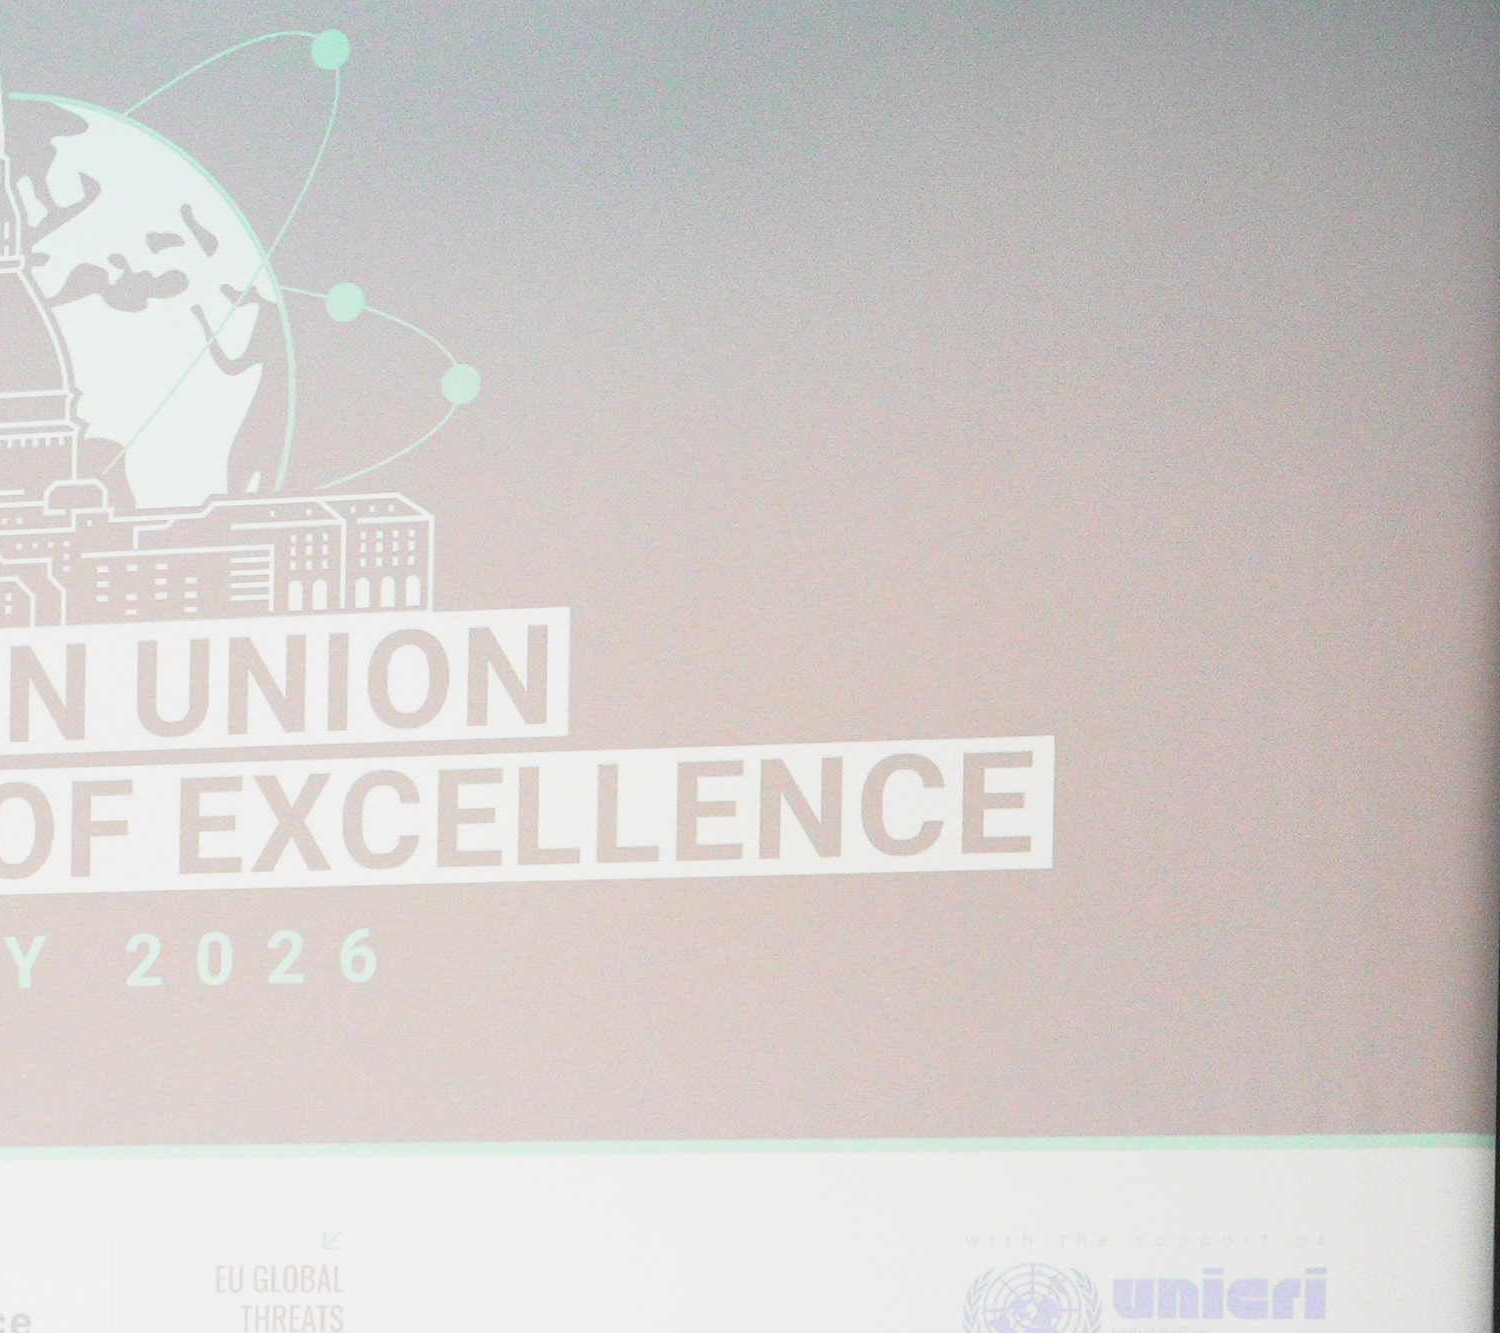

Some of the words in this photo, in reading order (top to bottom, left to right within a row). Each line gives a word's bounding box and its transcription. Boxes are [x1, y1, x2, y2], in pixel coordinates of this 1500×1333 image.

[134, 624, 551, 737] UNION
[177, 749, 1035, 876] EXCELLENCE
[125, 927, 378, 988] 2026
[214, 1265, 245, 1294] EU
[251, 1262, 345, 1294] GLOBAL
[1111, 1266, 1328, 1320] unicri
[240, 1303, 345, 1333] THREATS
